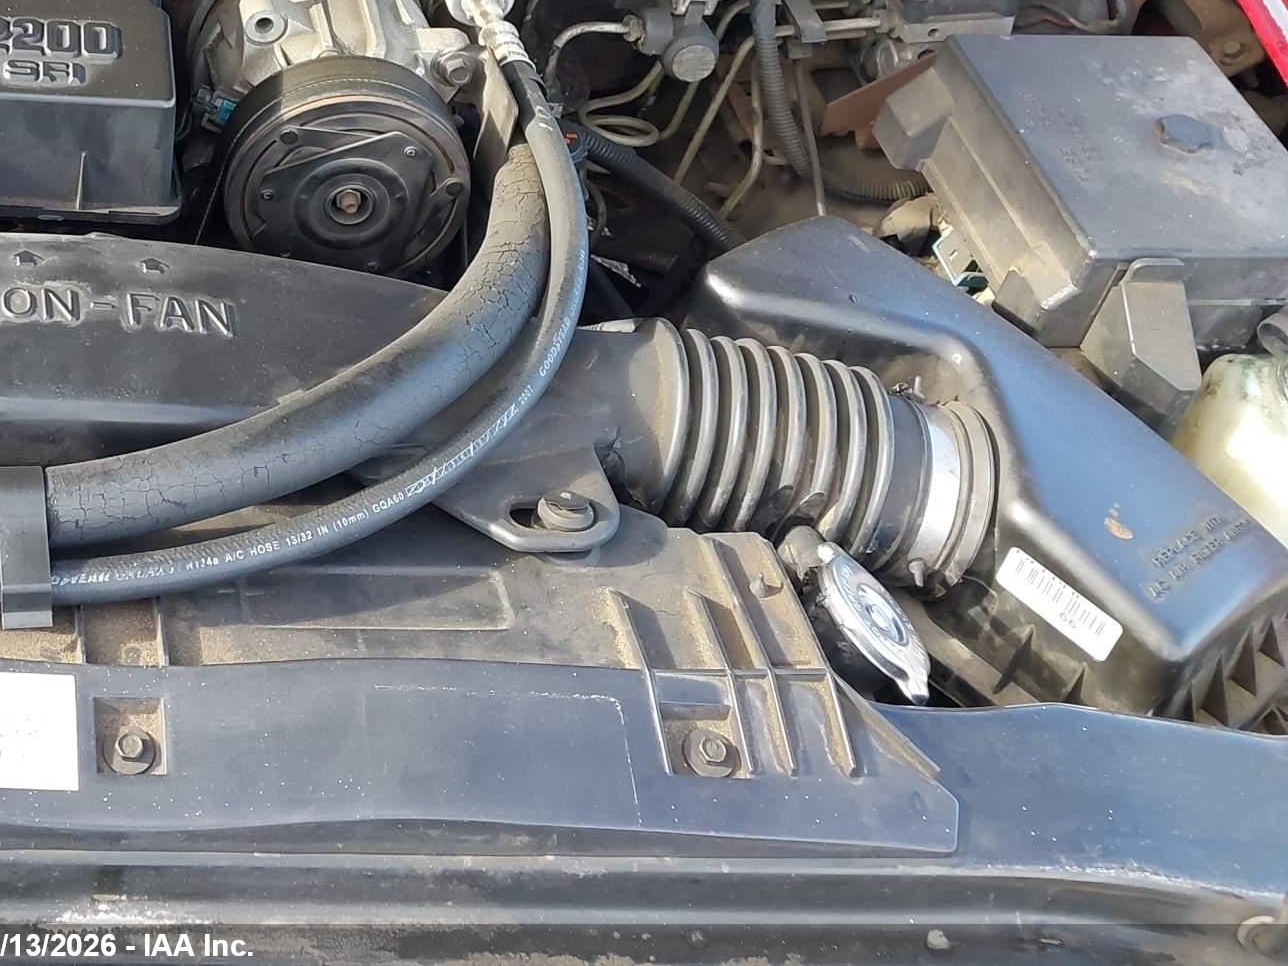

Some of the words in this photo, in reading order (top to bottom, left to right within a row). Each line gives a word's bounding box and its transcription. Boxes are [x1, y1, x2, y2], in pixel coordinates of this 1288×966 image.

[3, 60, 88, 85] SFI
[538, 315, 572, 377] GOODYEAR
[225, 550, 245, 564] A/C
[249, 540, 281, 558] HOSE
[285, 529, 314, 547] 13/32
[316, 524, 330, 537] IN
[332, 508, 370, 532] (10mm)
[371, 491, 405, 514] GQA60
